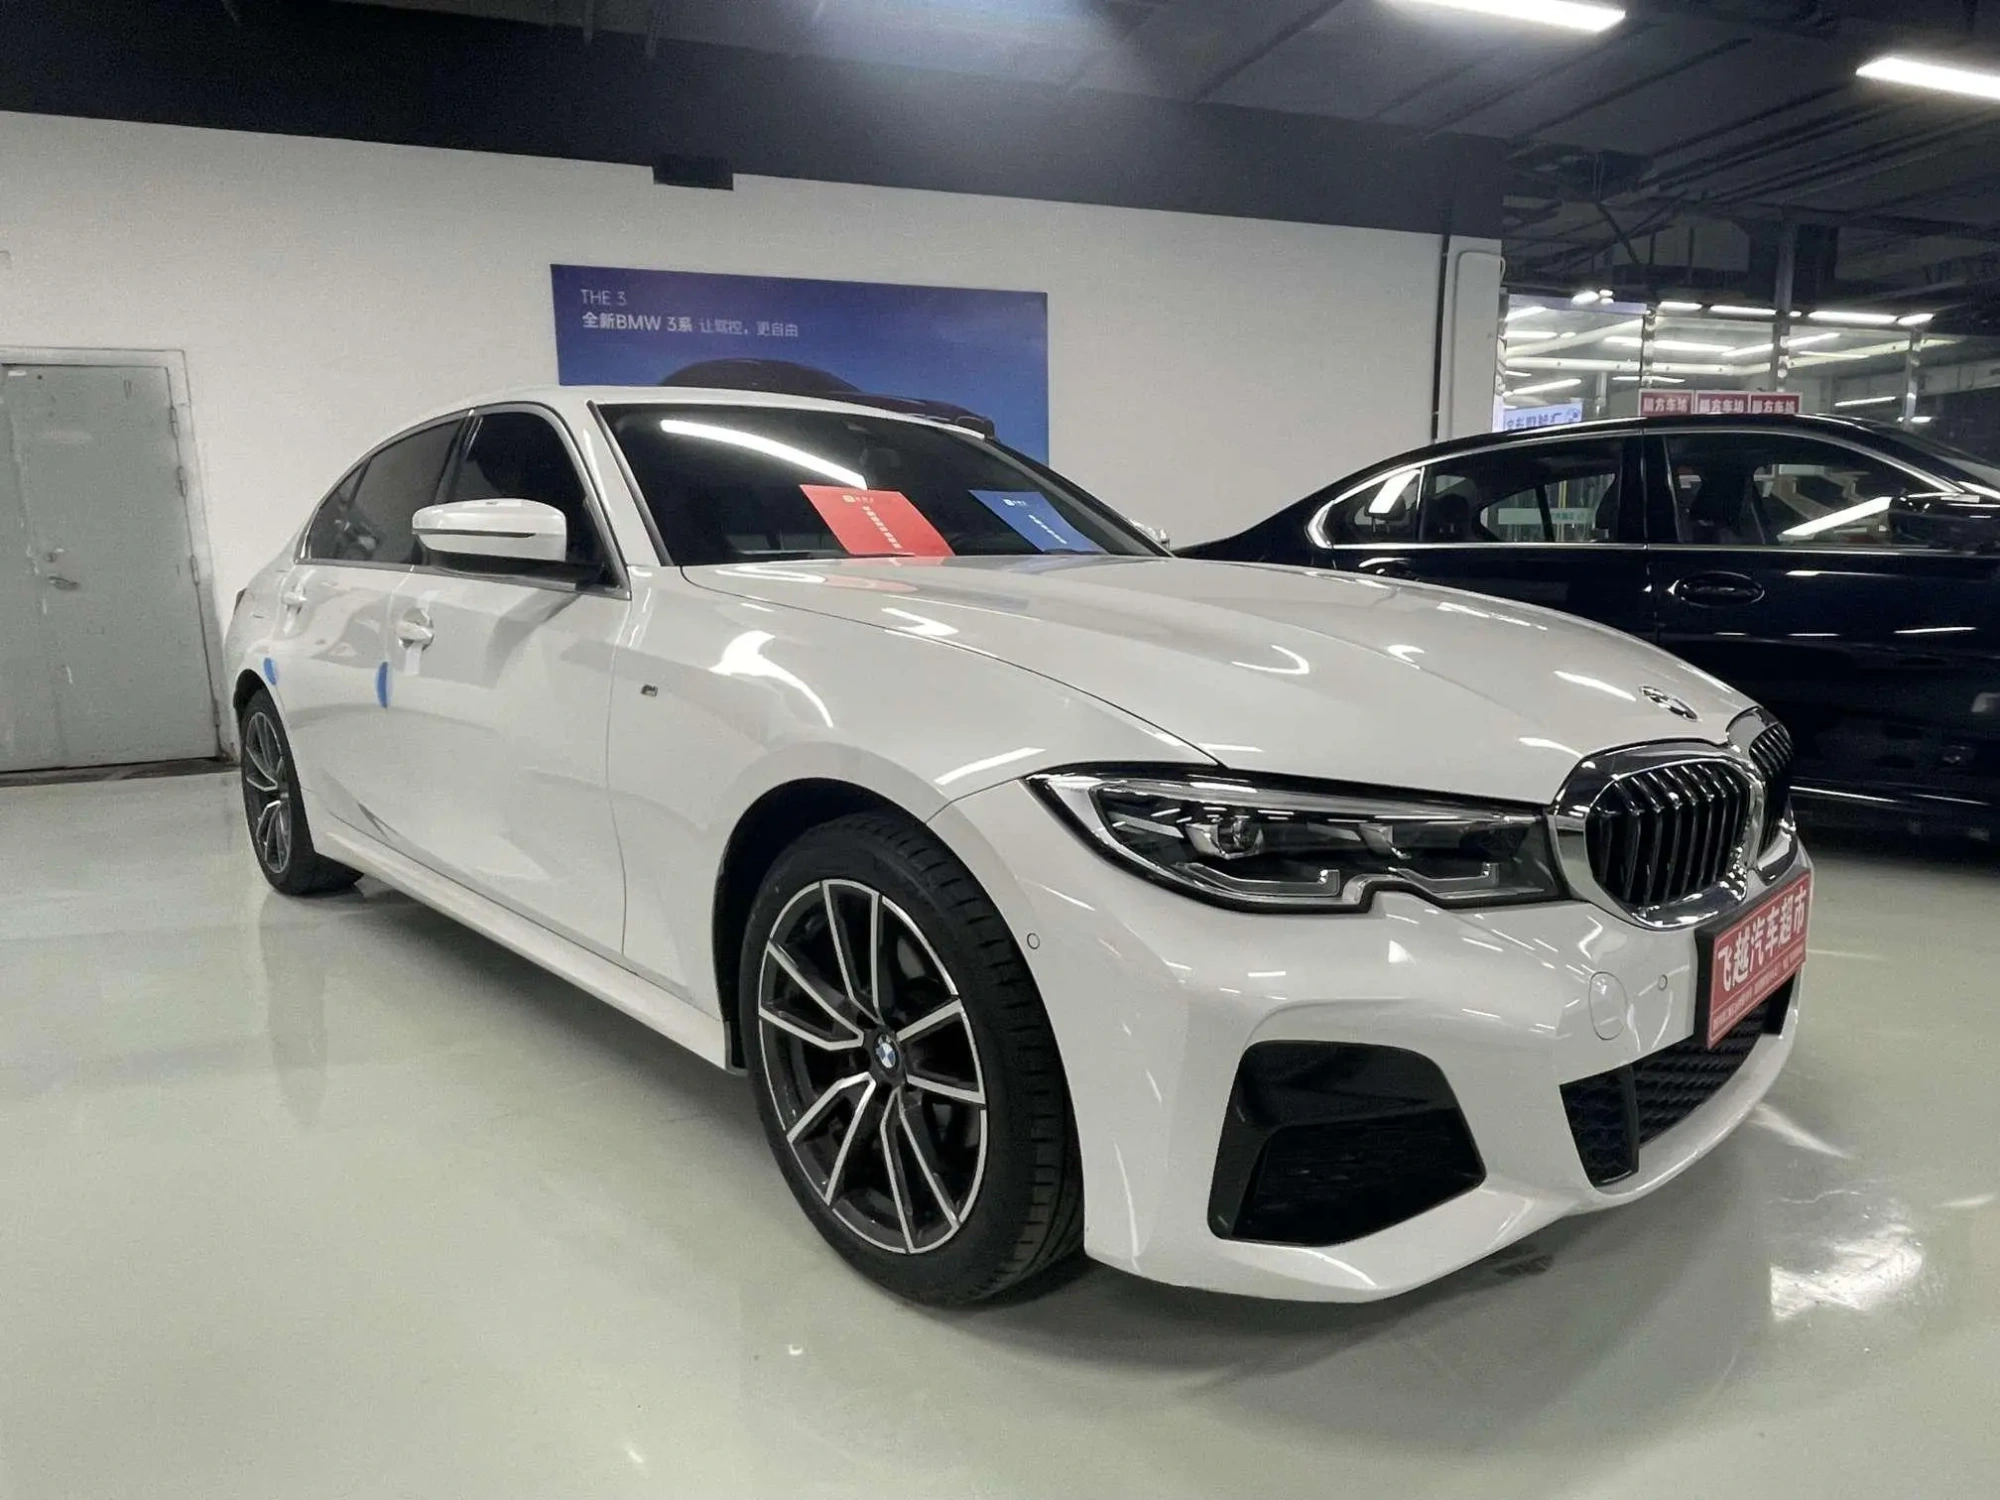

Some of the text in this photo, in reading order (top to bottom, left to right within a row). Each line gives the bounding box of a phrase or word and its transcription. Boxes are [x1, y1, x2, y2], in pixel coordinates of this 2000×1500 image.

[580, 289, 627, 306] THE 3
[582, 311, 662, 331] 全新BMW
[667, 316, 693, 333] 3系
[1718, 885, 1806, 992] 飞越汽车超市
